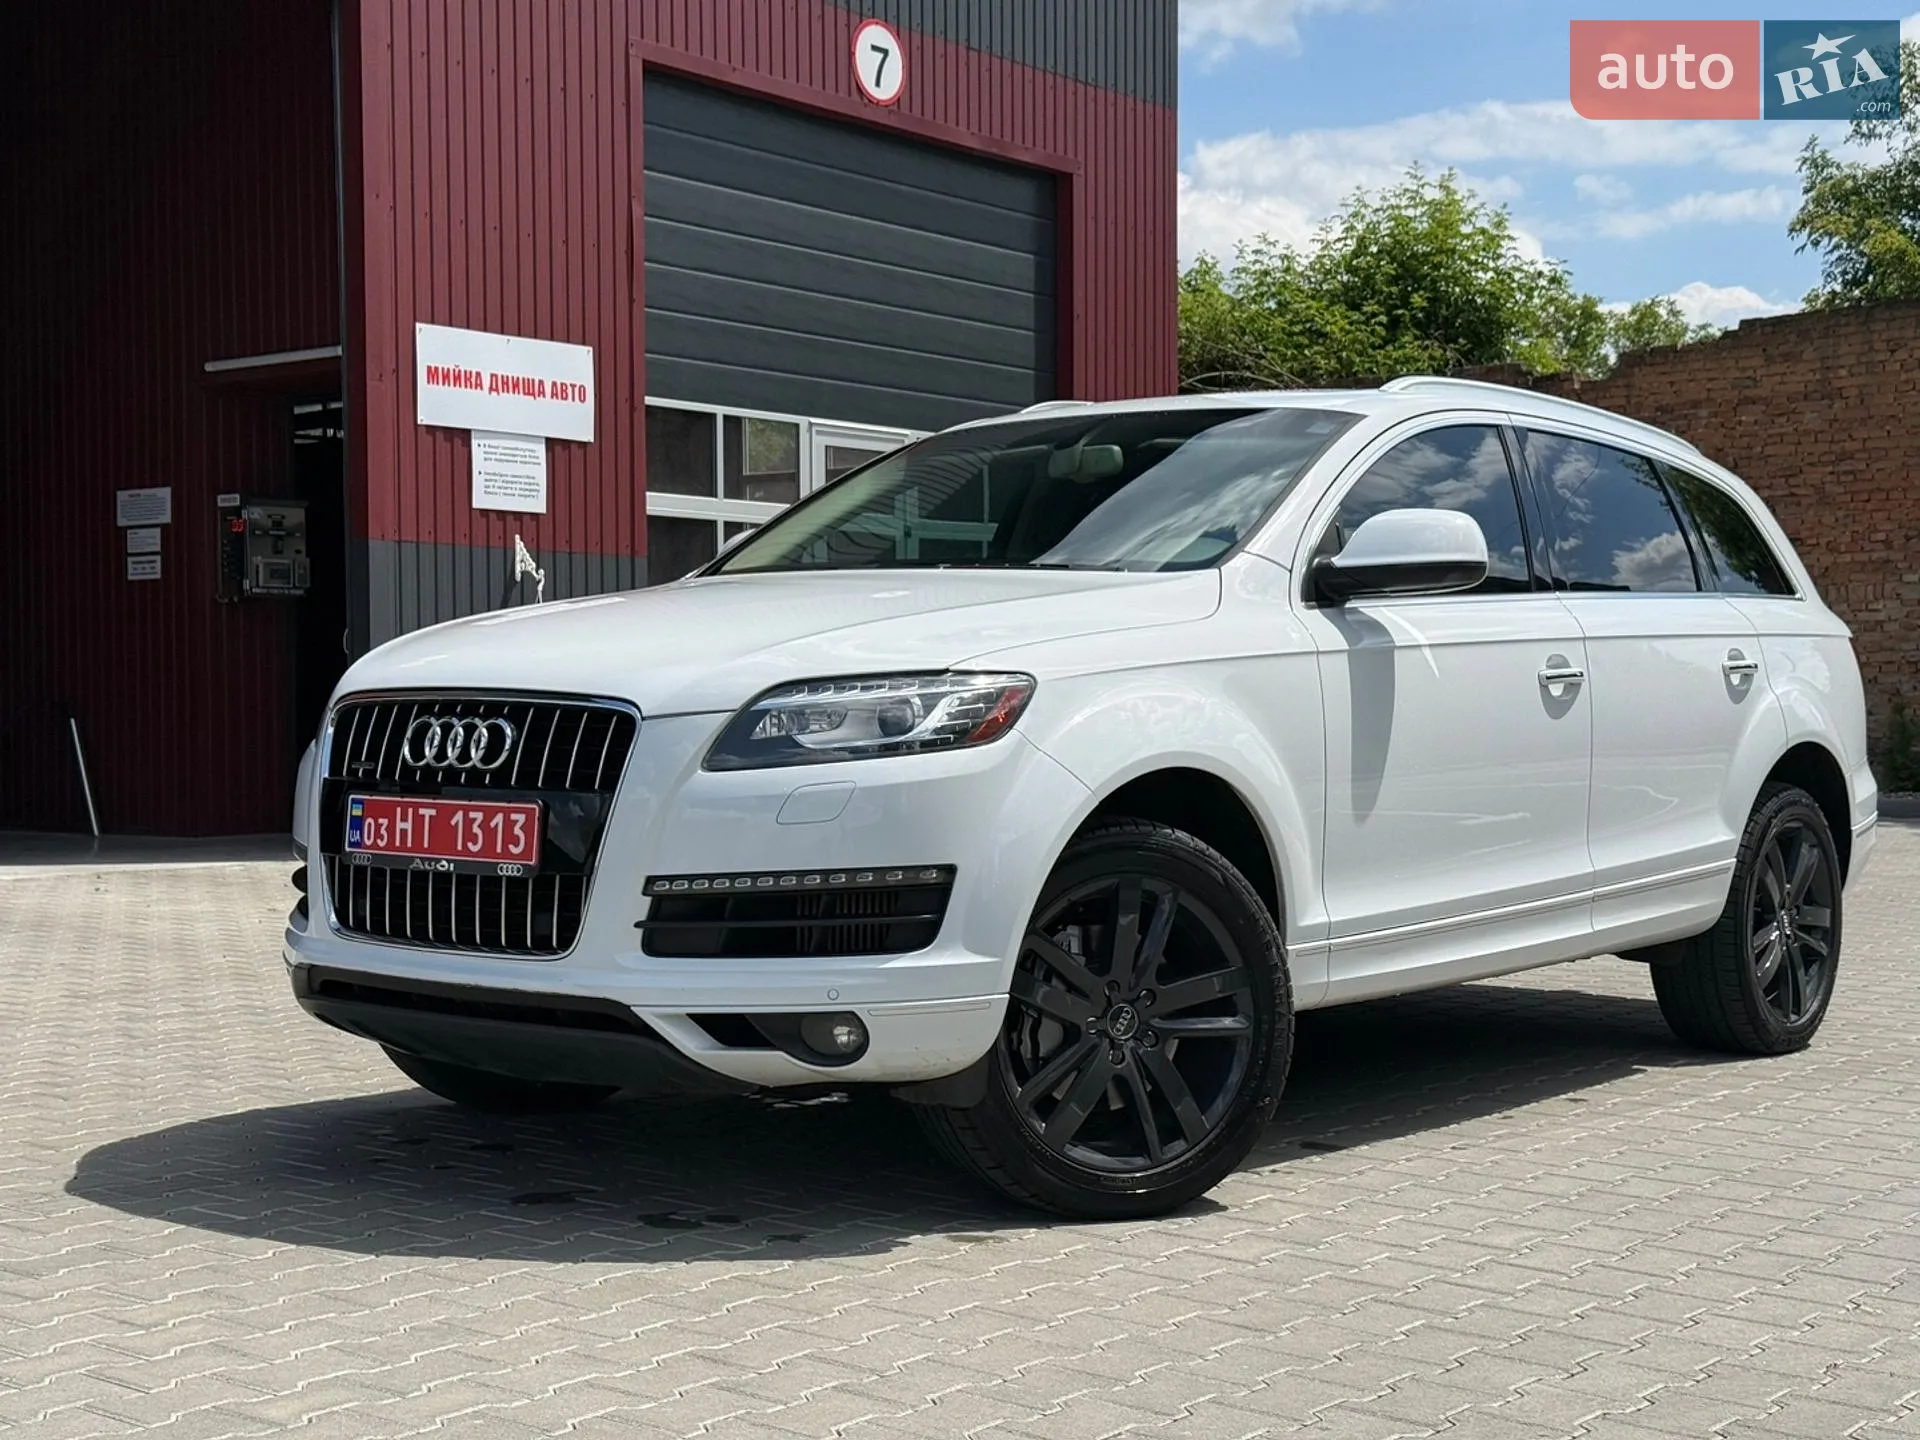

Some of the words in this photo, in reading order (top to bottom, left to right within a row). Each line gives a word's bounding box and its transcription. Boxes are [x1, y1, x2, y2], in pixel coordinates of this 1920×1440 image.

[870, 43, 890, 89] 7
[426, 364, 484, 391] МИЙКА
[488, 373, 546, 400] ДНИЩА
[550, 381, 587, 404] АВТО
[349, 830, 361, 843] UA
[363, 817, 388, 848] 03
[395, 806, 437, 849] HT
[450, 810, 526, 855] 1313
